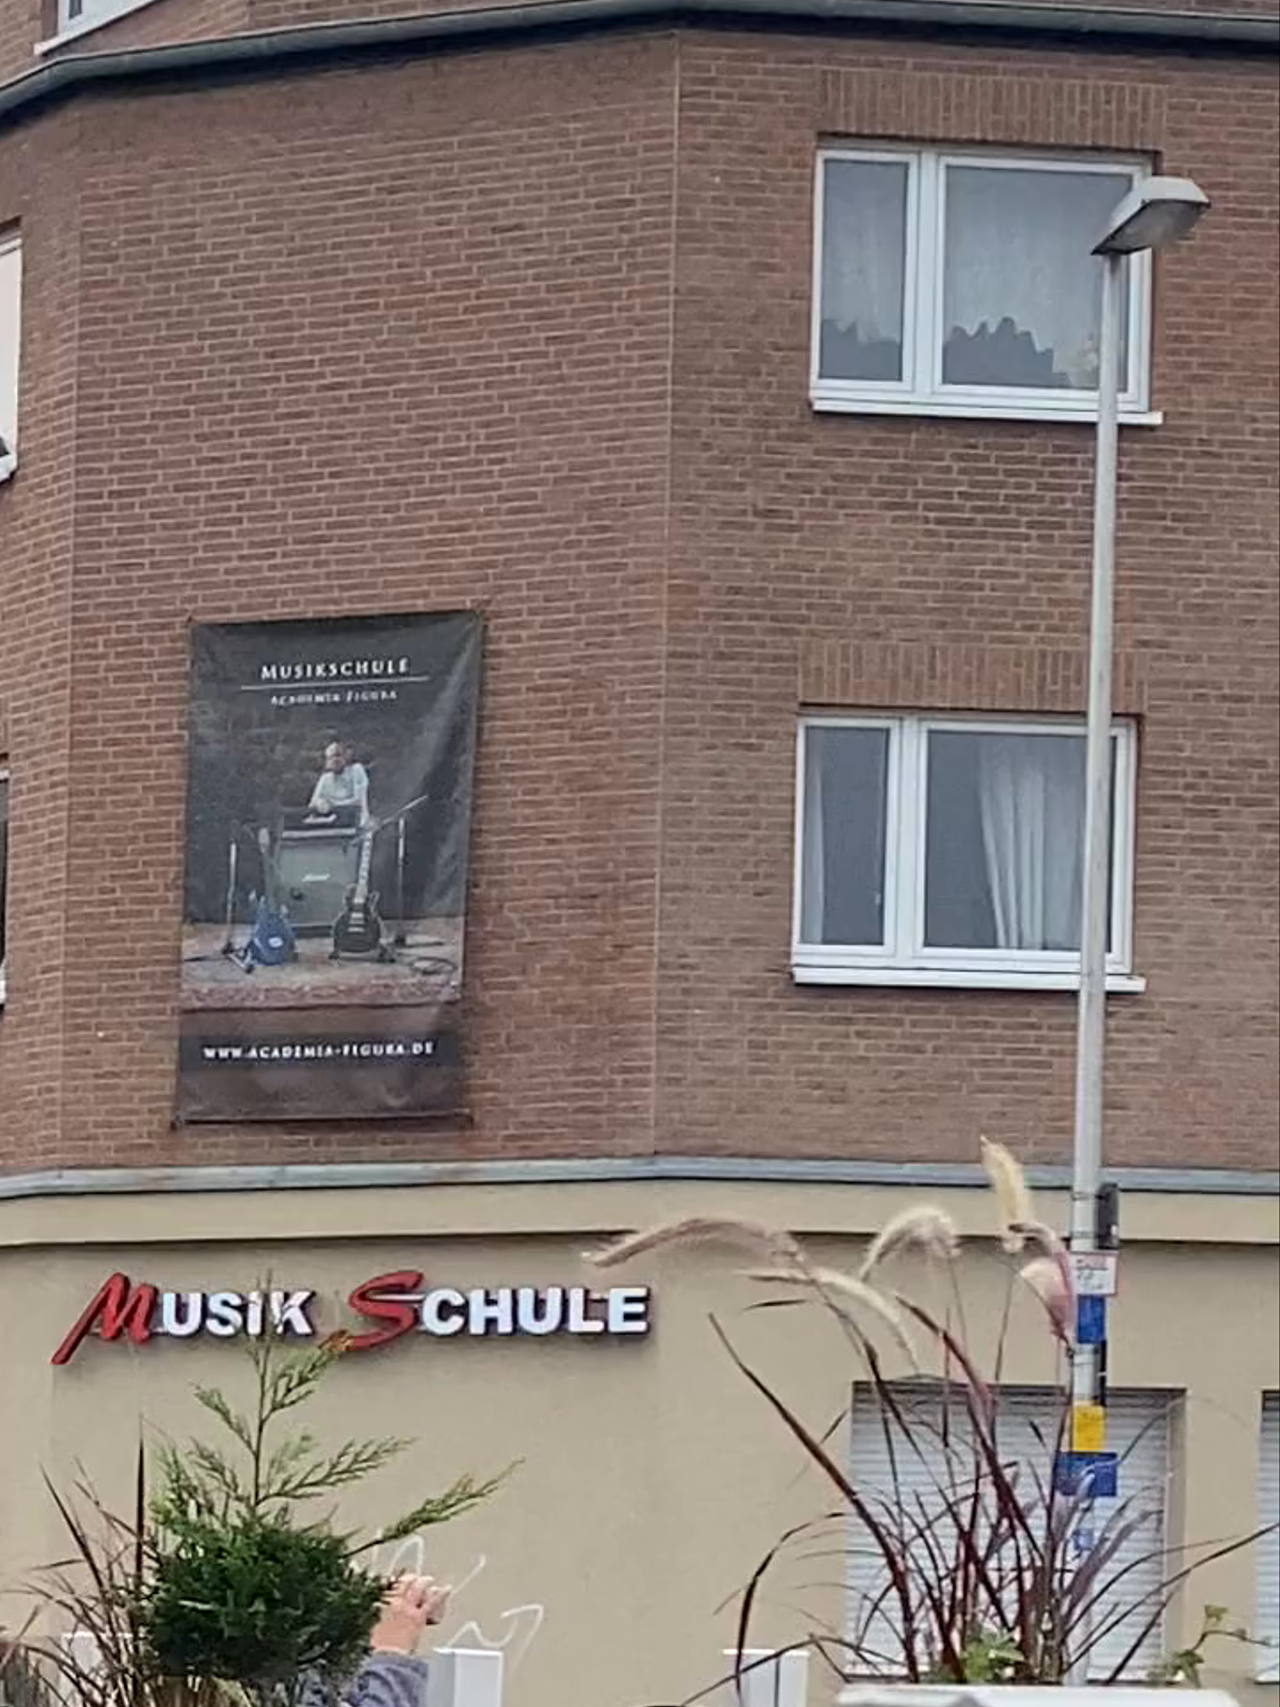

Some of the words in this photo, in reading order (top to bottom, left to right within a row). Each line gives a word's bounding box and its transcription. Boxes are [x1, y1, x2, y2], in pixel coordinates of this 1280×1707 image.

[260, 657, 410, 680] MUSIKSCHULE
[49, 1271, 316, 1366] MUSIK
[340, 1271, 649, 1351] SCHULE
